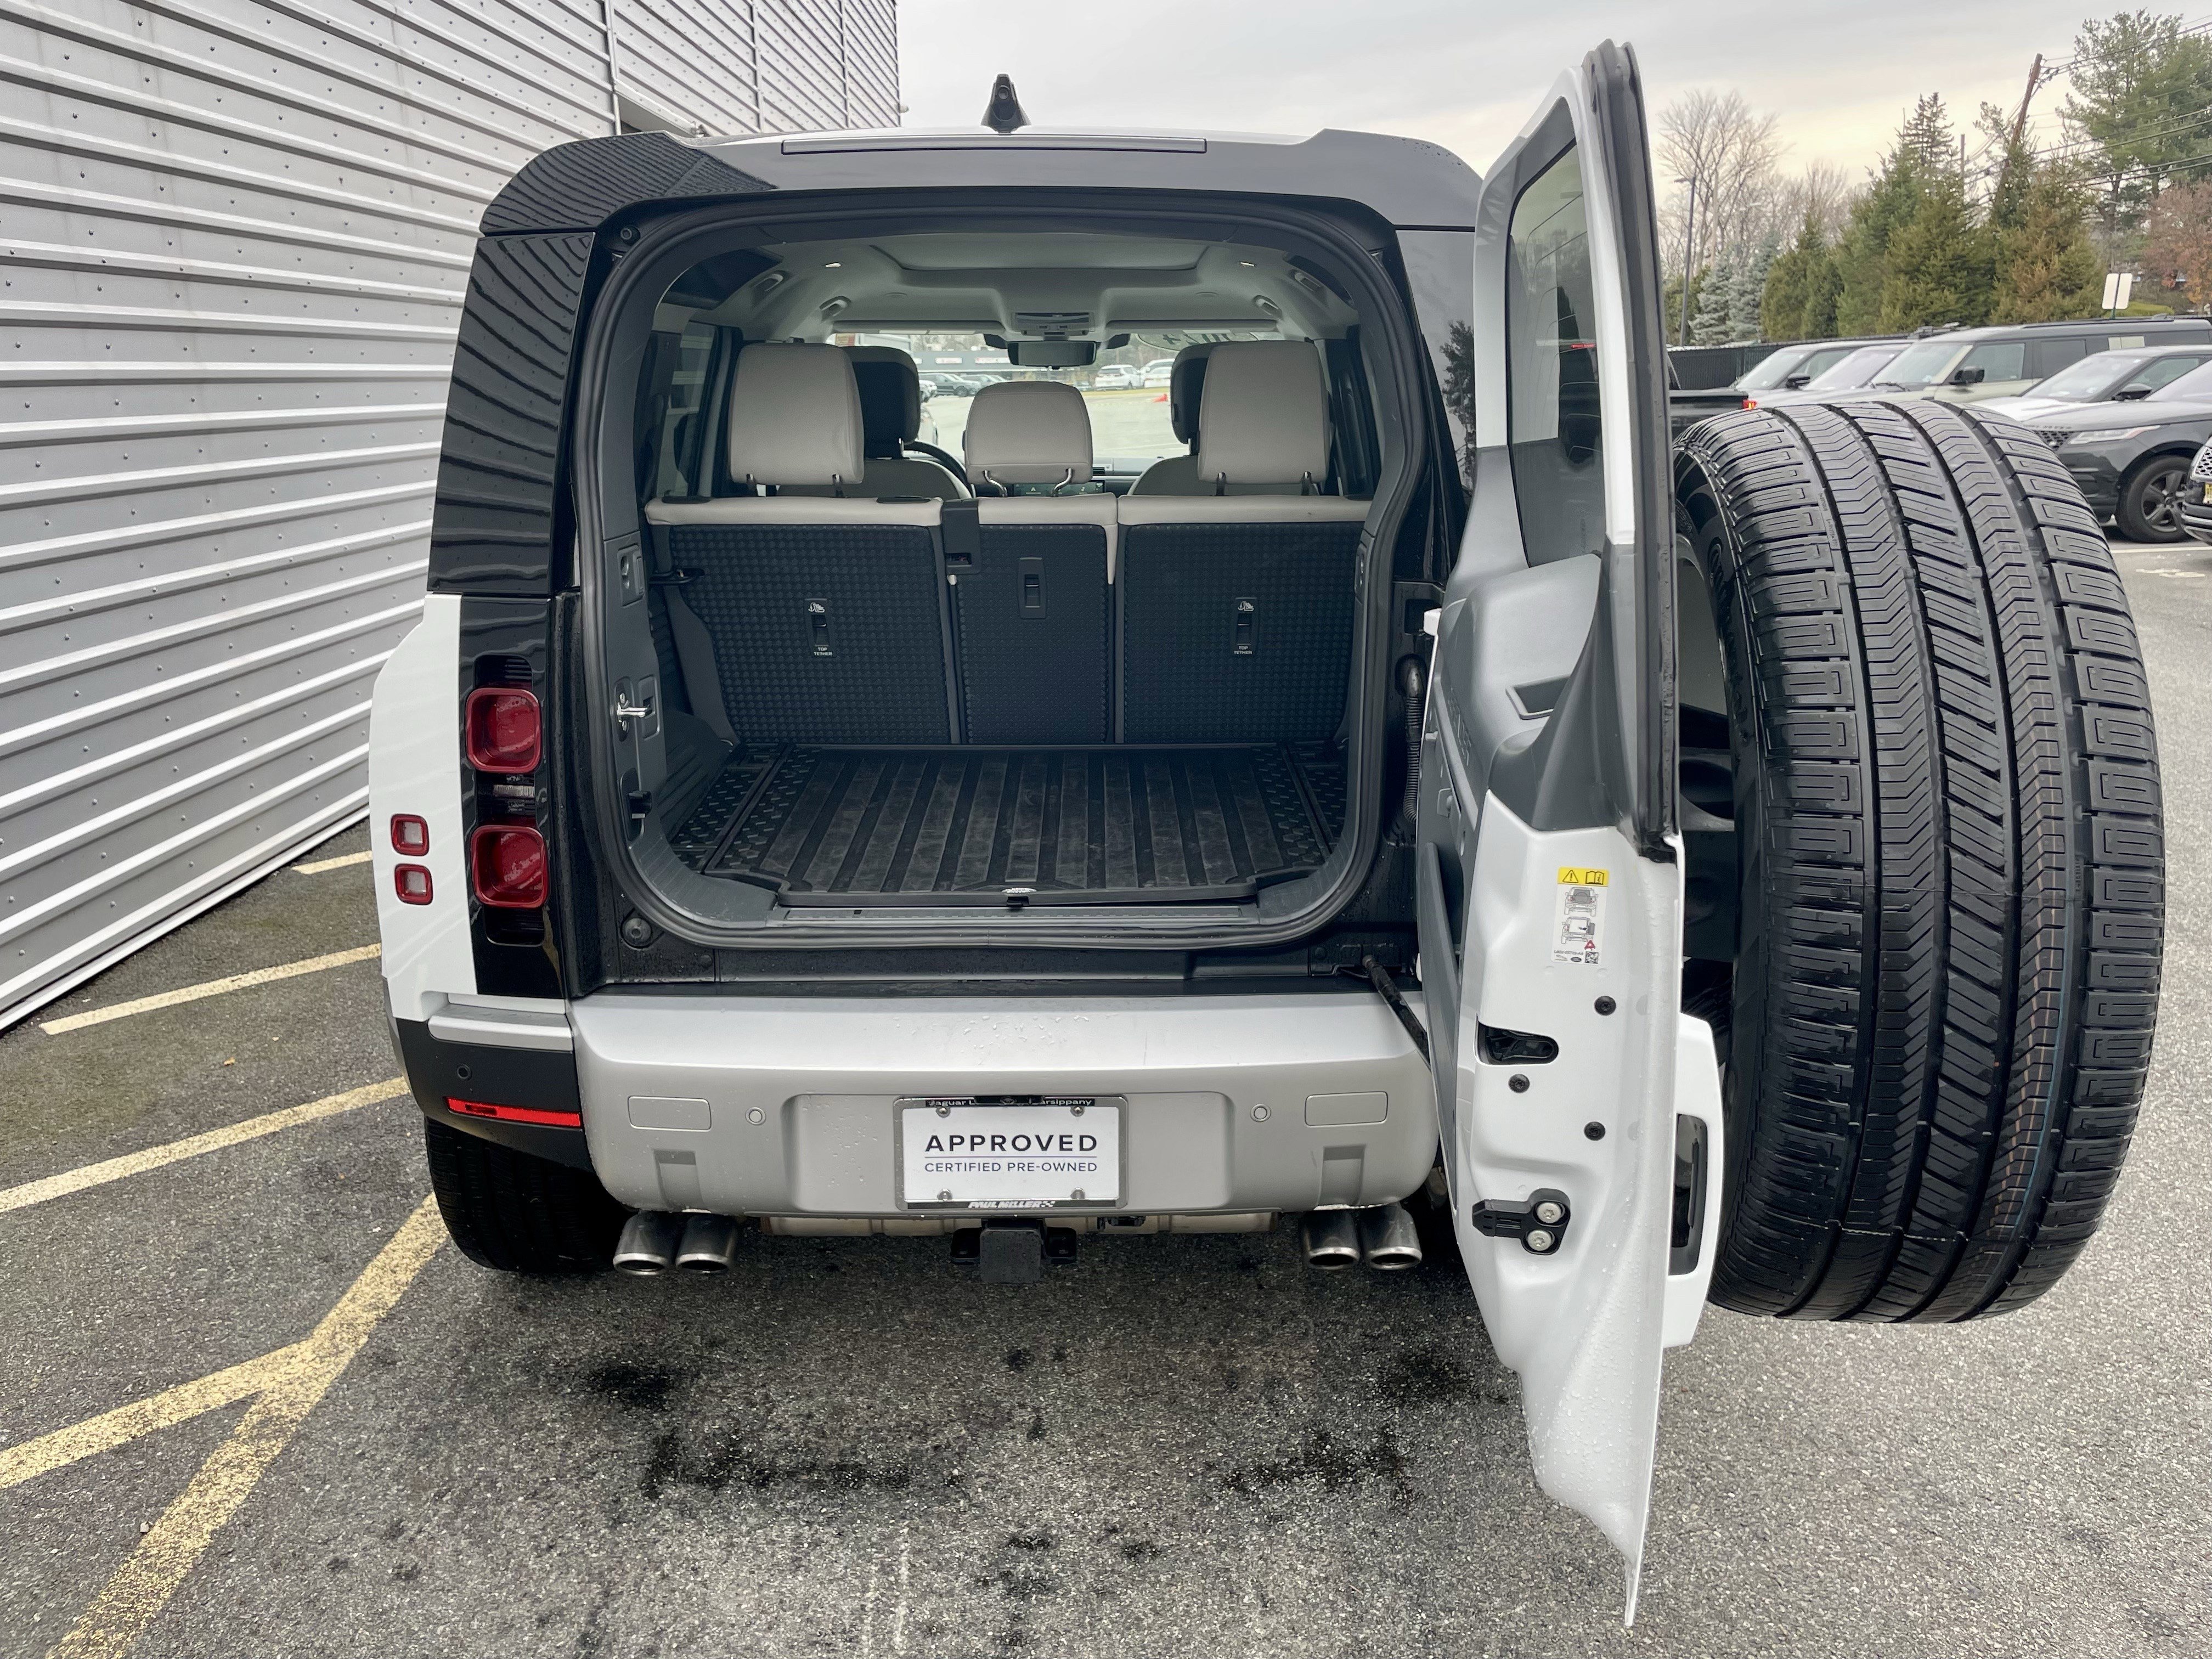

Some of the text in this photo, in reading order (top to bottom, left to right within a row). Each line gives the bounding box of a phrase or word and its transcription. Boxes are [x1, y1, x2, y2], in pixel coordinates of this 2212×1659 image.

[924, 1134, 1098, 1152] APPROVED
[924, 1162, 1098, 1172] CERTIFIED PRE-OWNED
